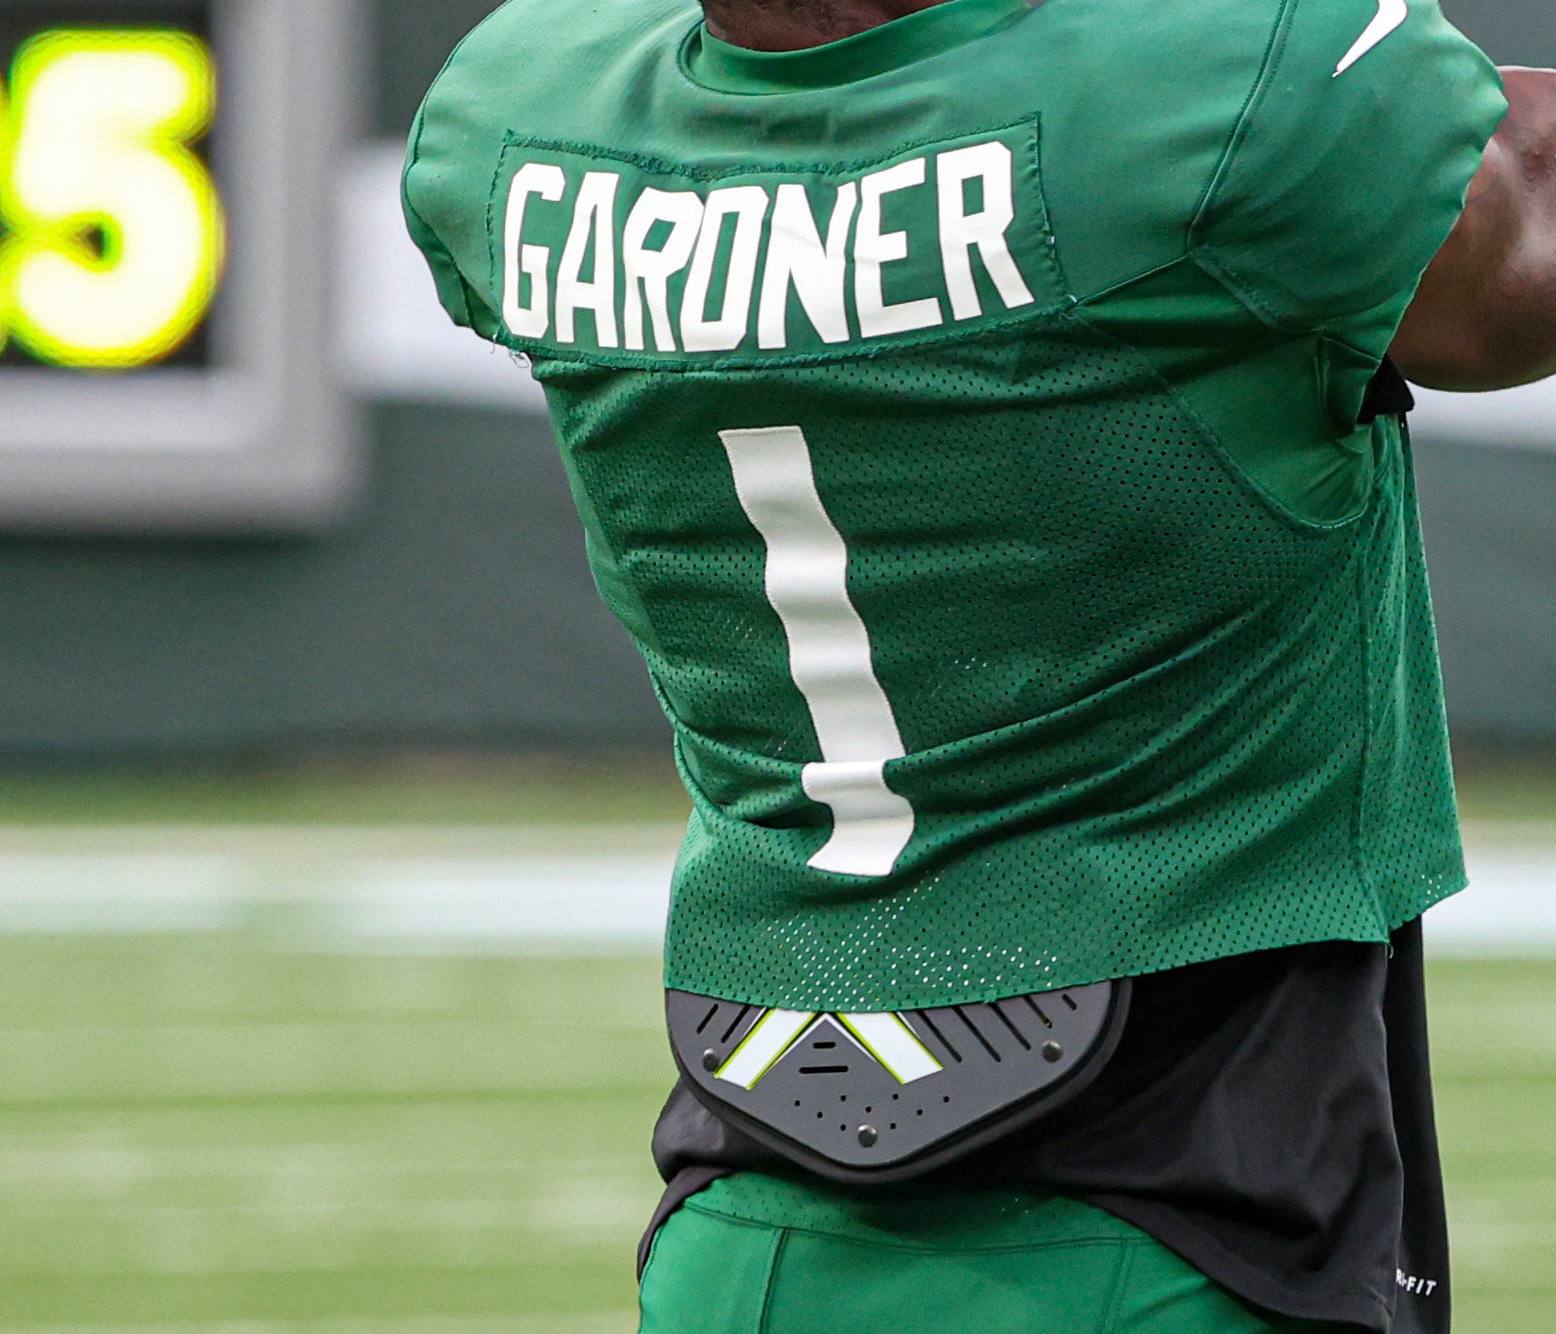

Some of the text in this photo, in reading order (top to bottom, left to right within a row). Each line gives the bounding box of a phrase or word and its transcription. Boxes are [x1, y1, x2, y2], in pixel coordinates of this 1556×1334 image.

[0, 25, 226, 373] 5
[502, 141, 1036, 353] GARDNER
[717, 425, 916, 877] 1
